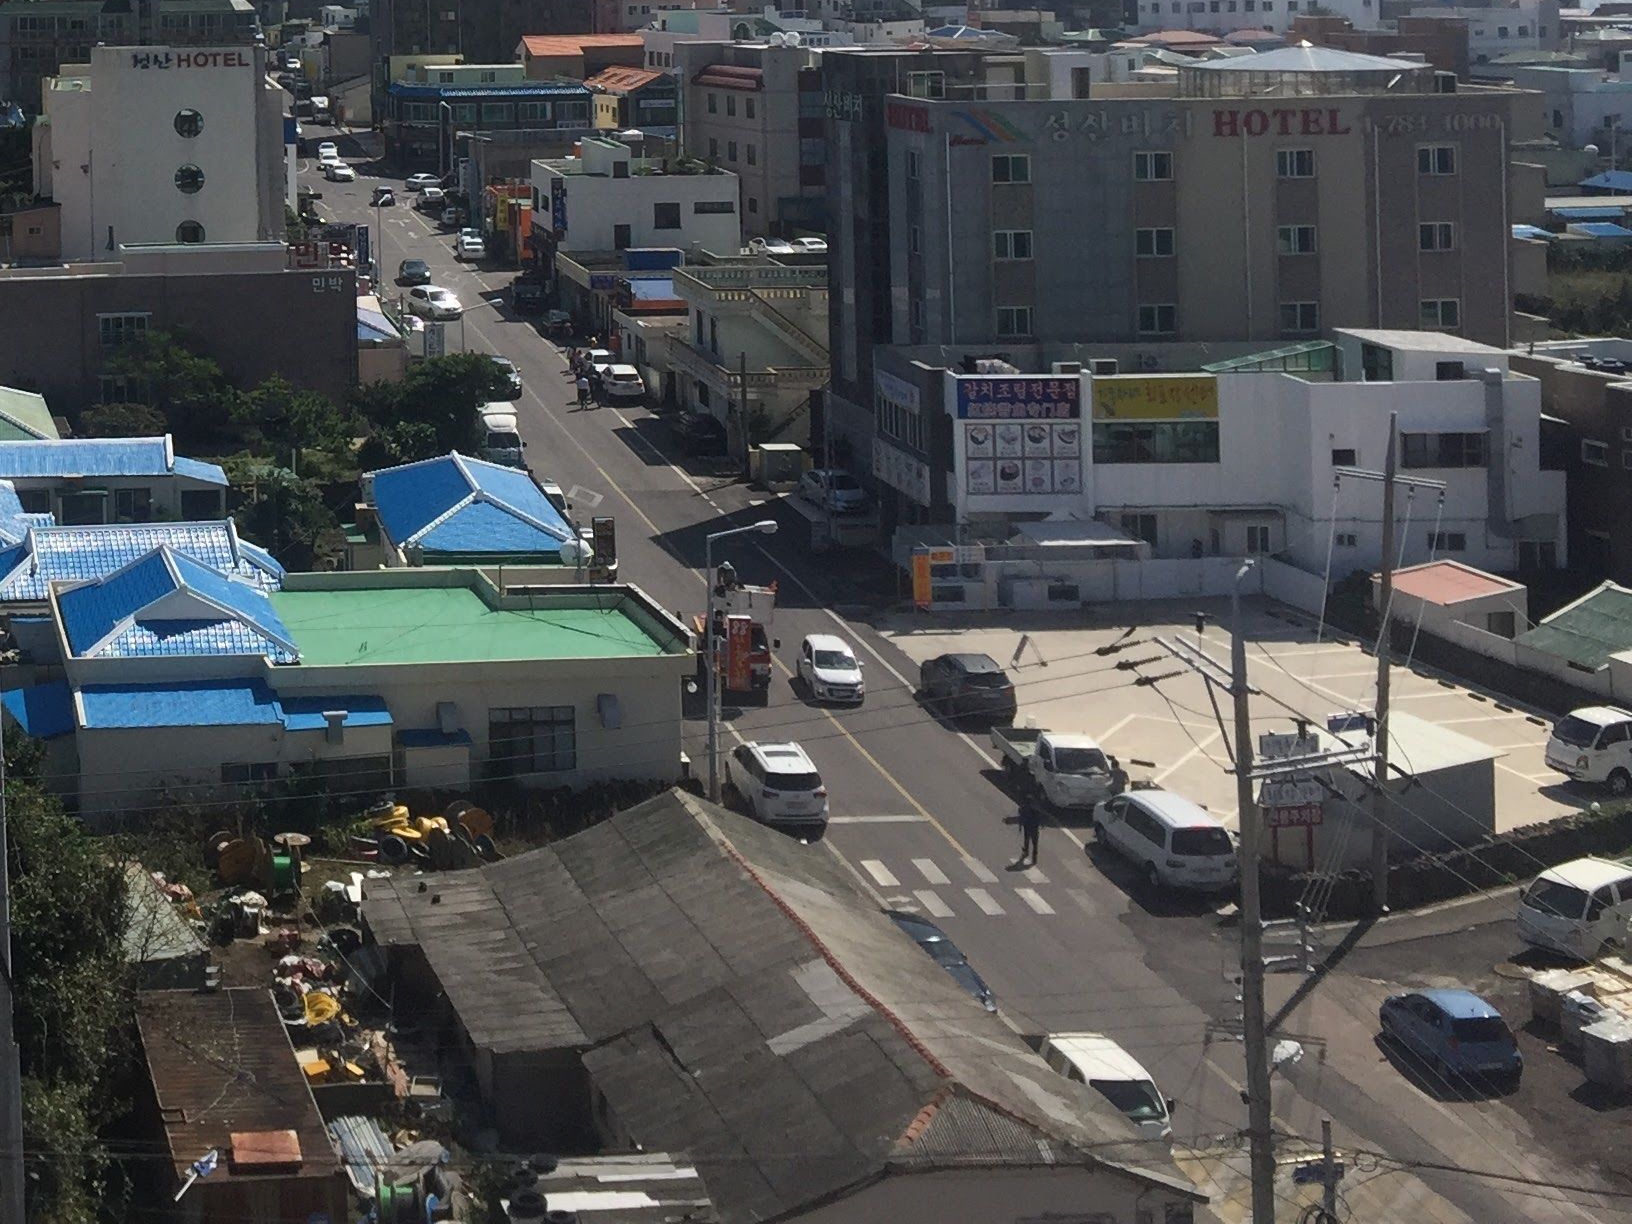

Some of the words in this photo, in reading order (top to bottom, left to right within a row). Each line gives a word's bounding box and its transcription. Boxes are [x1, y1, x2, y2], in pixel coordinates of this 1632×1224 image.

[177, 52, 250, 68] HOTEL
[1045, 109, 1193, 142] 성산비치
[1212, 108, 1352, 137] HOTEL
[312, 277, 344, 293] 민박
